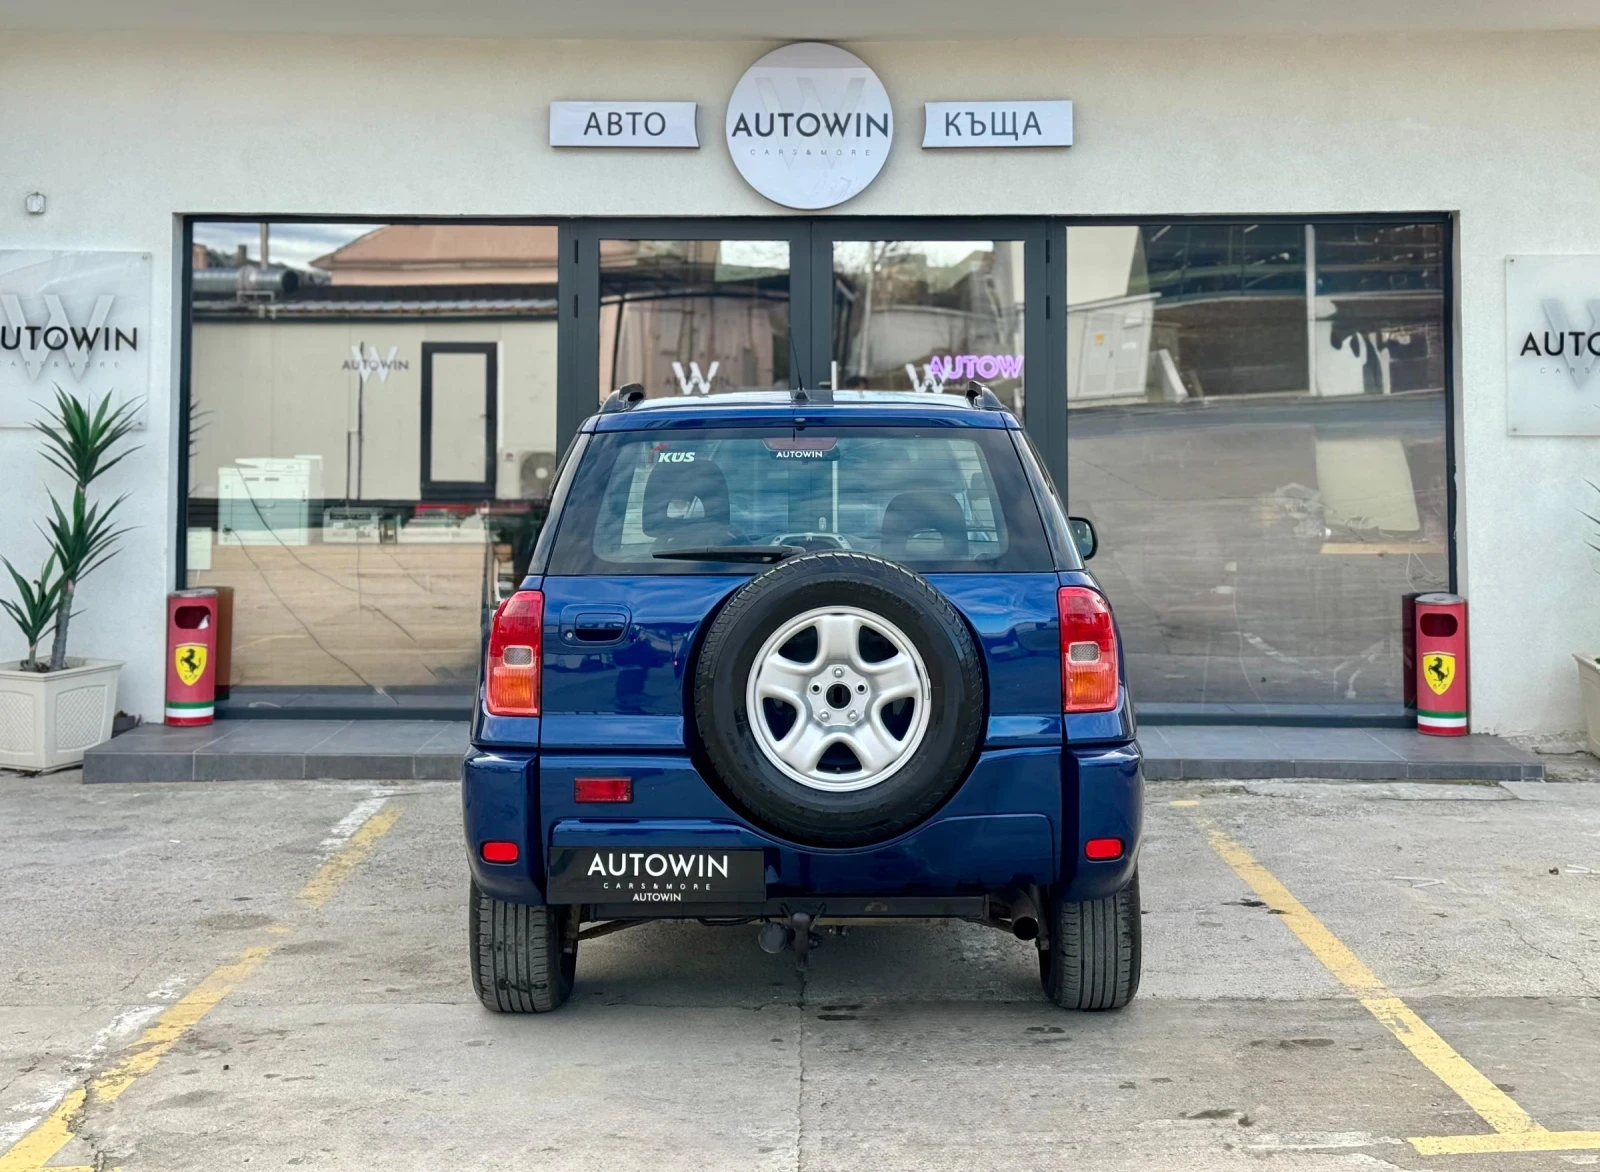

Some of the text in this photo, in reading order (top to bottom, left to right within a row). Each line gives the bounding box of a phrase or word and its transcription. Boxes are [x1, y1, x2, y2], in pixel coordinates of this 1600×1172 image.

[583, 112, 666, 136] АВТО
[731, 112, 889, 138] AUTOWIN
[945, 111, 1042, 141] КЪЩА
[341, 360, 409, 371] AUTOWIN
[929, 355, 1024, 379] AUTOW
[776, 450, 823, 458] AUTOWIN
[587, 852, 728, 878] AUTOWIN
[632, 892, 682, 902] AUTOWIN
